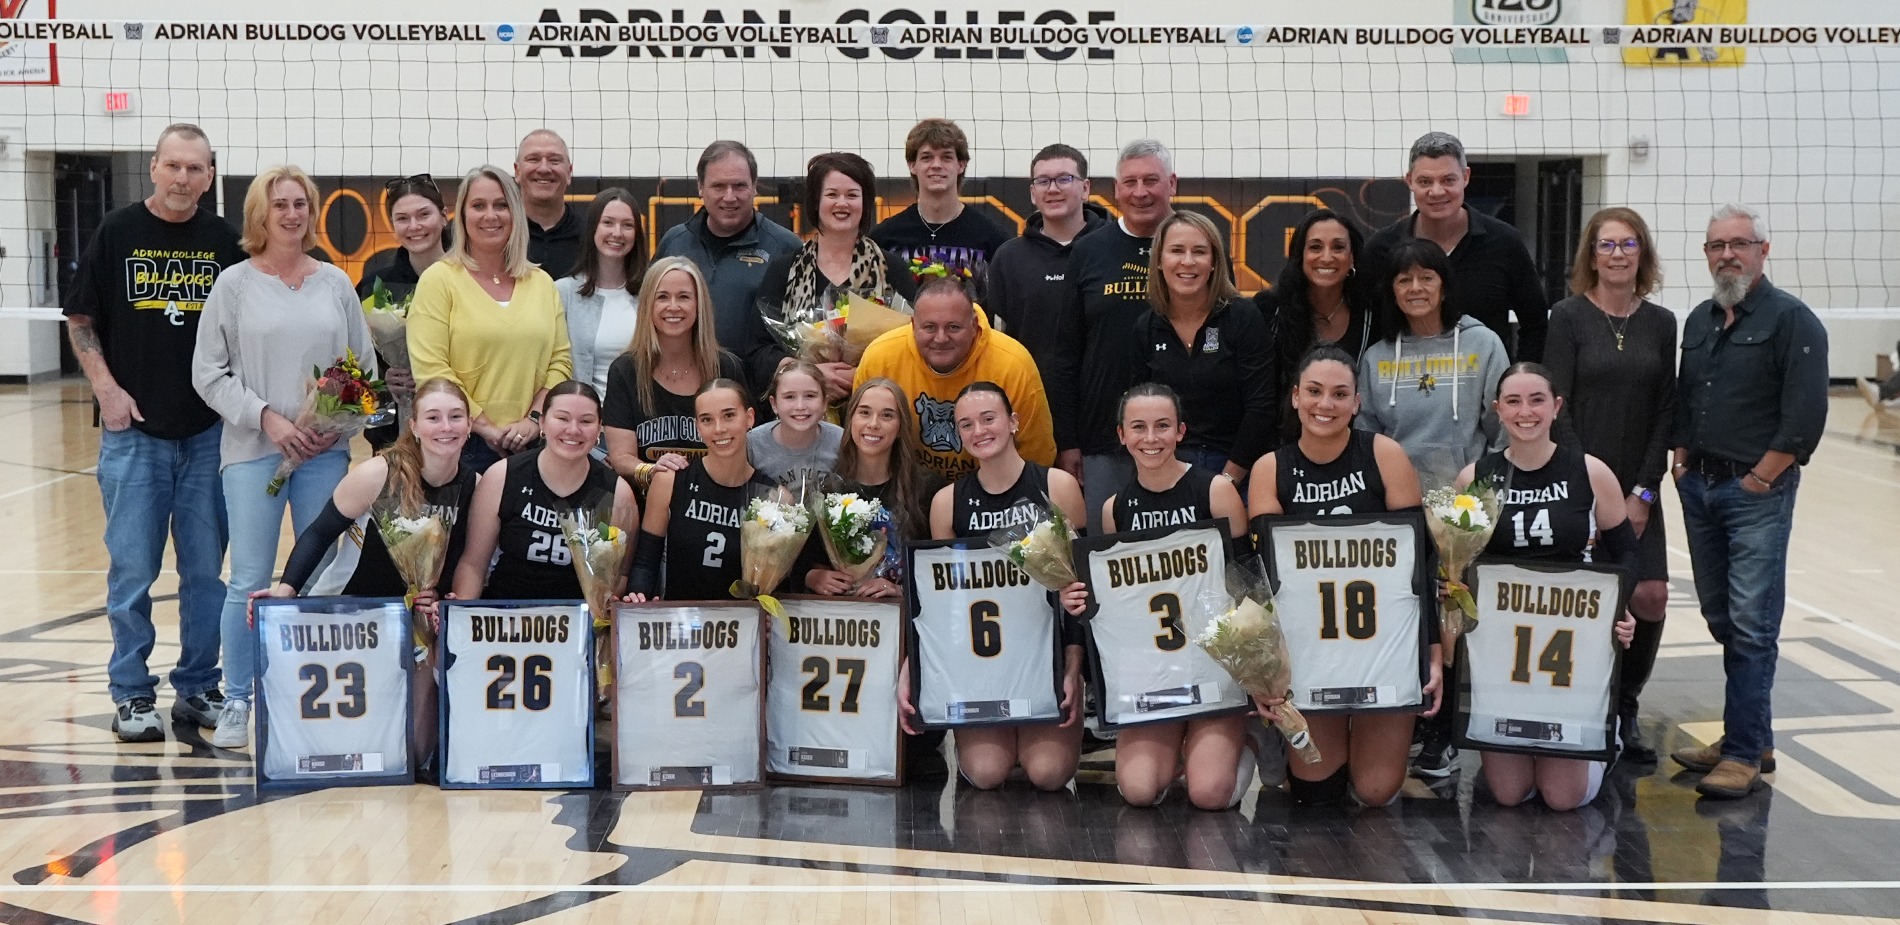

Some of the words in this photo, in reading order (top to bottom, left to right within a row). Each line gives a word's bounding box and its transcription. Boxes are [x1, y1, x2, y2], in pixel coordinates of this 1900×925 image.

[155, 23, 238, 41] ADRIAN
[245, 24, 346, 41] BULLDOG
[353, 24, 486, 41] VOLLEYBALL
[526, 8, 791, 58] ADRIAN
[528, 25, 611, 42] ADRIAN
[619, 25, 718, 42] BULLDOG
[725, 26, 858, 43] VOLLEYBALL
[900, 27, 982, 43] ADRIAN
[990, 27, 1089, 44] BULLDOG
[1095, 27, 1226, 44] VOLLEYBALL
[1266, 27, 1348, 44] ADRIAN
[1356, 27, 1454, 44] BULLDOG
[1461, 27, 1590, 44] VOLLEYBALL
[1631, 27, 1713, 44] ADRIAN
[1720, 27, 1817, 44] BULLDOG
[105, 93, 129, 111] EXIT
[132, 249, 170, 259] ADRIAN
[172, 251, 216, 260] COLLEGE
[126, 257, 221, 302] DAD
[136, 271, 214, 287] BULLDOGS
[1104, 281, 1150, 296] BULL
[636, 415, 679, 448] ADRIAN
[1292, 471, 1366, 503] ADRIAN
[1495, 480, 1569, 505] ADRIAN
[685, 498, 744, 528] ADRIA
[968, 503, 1037, 531] ADRIAN
[1131, 505, 1197, 531] ADRIAN
[1511, 508, 1554, 548] 14
[526, 530, 572, 566] 26
[702, 531, 727, 568] 2
[1295, 537, 1397, 570] BULLDOGS
[932, 559, 1031, 590] BULLDOGS
[1107, 543, 1209, 589] BULLDOGS
[1317, 579, 1376, 641] 18
[1496, 581, 1601, 619] BULLDOGS
[279, 621, 379, 653] BULLDOGS
[471, 615, 570, 644] BULLDOGS
[638, 619, 740, 651] BULLDOGS
[789, 616, 881, 648] BULLDOGS
[969, 599, 1002, 659] 6
[1149, 591, 1188, 653] 3
[1510, 624, 1574, 688] 14
[299, 660, 368, 721] 23
[485, 653, 553, 712] 26
[673, 661, 707, 719] 2
[800, 655, 867, 715] 27
